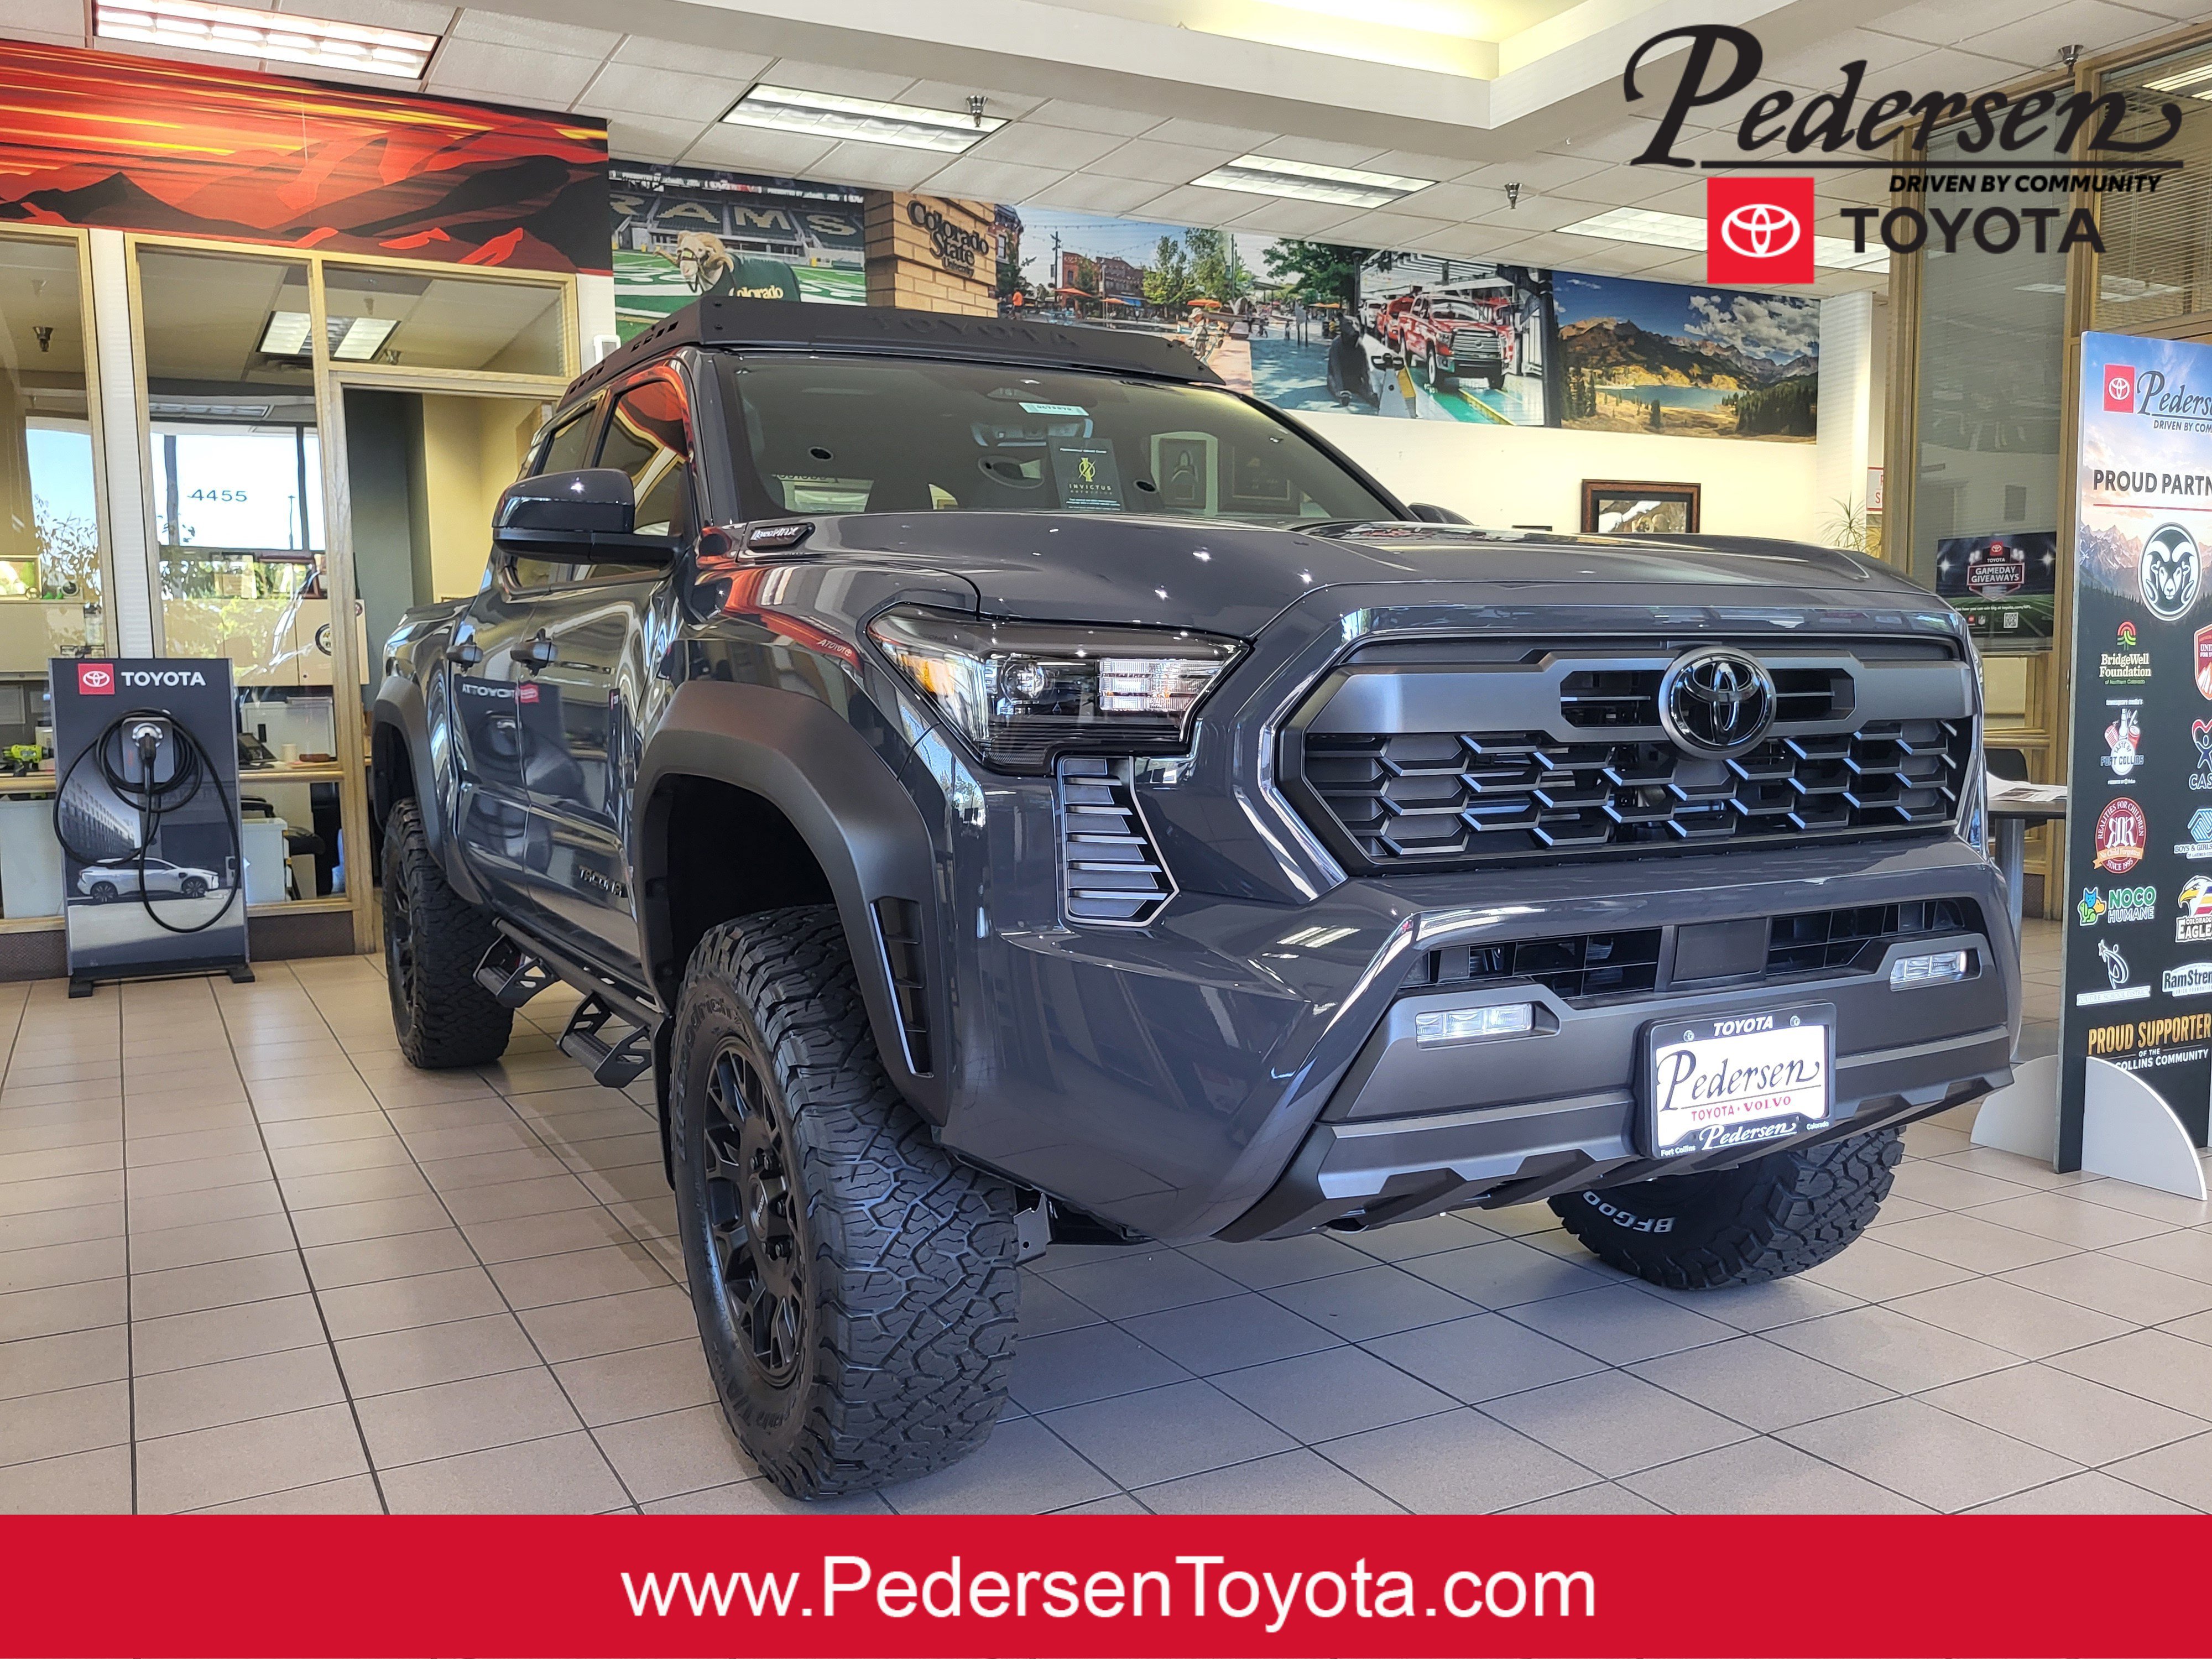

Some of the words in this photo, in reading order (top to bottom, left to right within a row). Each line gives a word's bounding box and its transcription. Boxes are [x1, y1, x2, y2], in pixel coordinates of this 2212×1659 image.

[907, 200, 989, 255] Colorado
[930, 230, 974, 266] State
[871, 316, 1080, 348] TOYOTA
[2137, 371, 2212, 416] Peders
[2153, 420, 2182, 430] DRIVEN
[2184, 422, 2194, 431] BY
[2093, 469, 2157, 493] PROUD
[188, 489, 248, 502] 4455
[1971, 573, 2020, 583] GIVEAWAYS
[1975, 566, 2016, 575] GAMEDAY
[2101, 653, 2150, 667] BridgeWell
[121, 671, 206, 687] TOYOTA
[2099, 666, 2151, 677] Foundation
[2114, 741, 2126, 753] TASTE
[2101, 756, 2117, 766] FORT
[2119, 755, 2144, 765] COLLINS
[2098, 804, 2117, 839] REALITIES
[2117, 801, 2127, 810] FOR
[2128, 803, 2144, 836] CHILDREN
[2106, 860, 2122, 870] SINCE
[2122, 858, 2133, 870] 1995
[2109, 886, 2157, 909] NOCO
[2107, 906, 2154, 924] HUMANE
[2178, 919, 2212, 940] EAGLE
[2078, 995, 2101, 1003] POUDRE
[2103, 992, 2125, 1000] SCHOOL
[1713, 1016, 1773, 1037] TOYOTA
[2088, 1024, 2134, 1055] PROUD
[2137, 1013, 2212, 1048] SUPPORTER
[2148, 1048, 2161, 1056] THE
[2155, 1048, 2209, 1066] COMMUNITY
[1656, 1050, 1820, 1112] Pedersen
[1691, 1105, 1735, 1121] TOYOTA
[1744, 1097, 1791, 1112] VOLVO
[1807, 1121, 1829, 1130] Colorado
[1699, 1122, 1797, 1150] Pedersen
[1661, 1146, 1674, 1157] Fort
[1674, 1145, 1696, 1154] Collins
